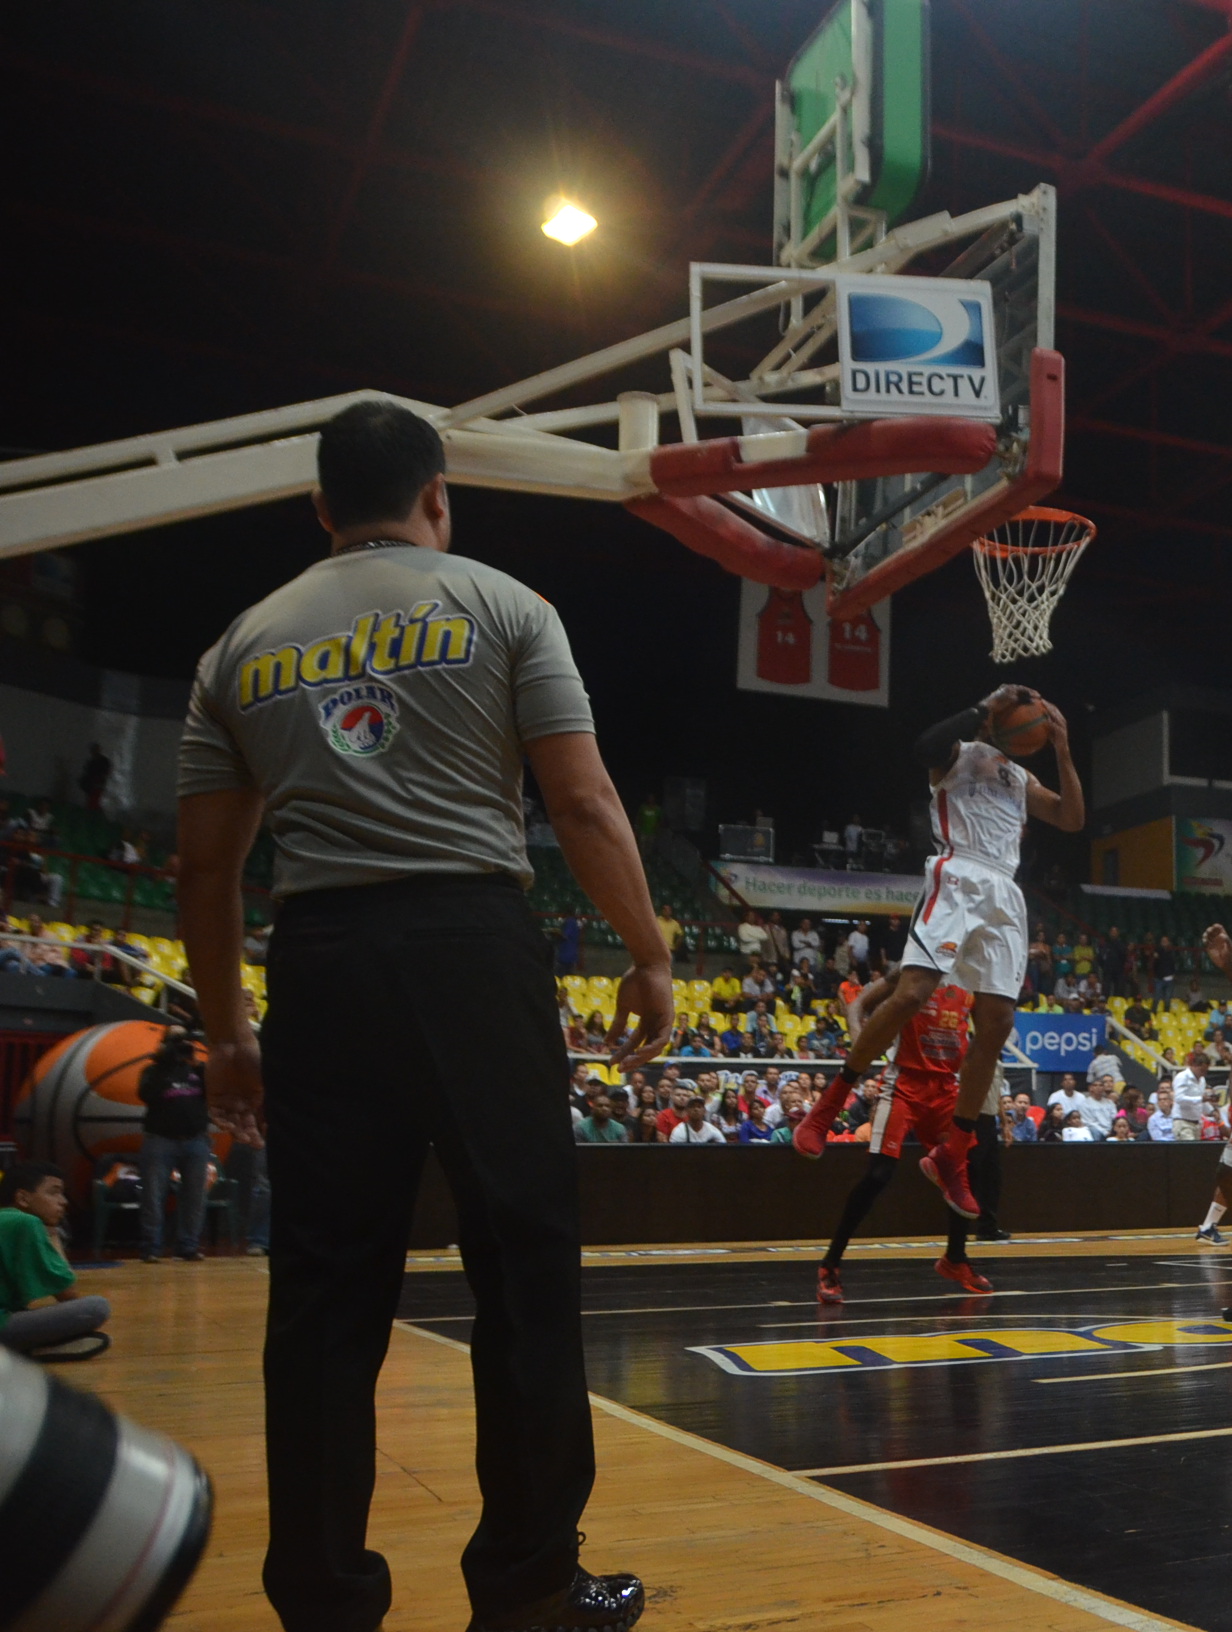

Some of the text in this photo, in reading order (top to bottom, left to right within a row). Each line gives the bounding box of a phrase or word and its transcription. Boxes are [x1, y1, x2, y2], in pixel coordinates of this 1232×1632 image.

[851, 368, 985, 399] DIRECTV
[775, 630, 797, 644] 14
[842, 621, 869, 642] 14
[239, 600, 477, 715] maltín
[319, 684, 398, 722] POLAR
[745, 876, 793, 895] Hacer
[798, 880, 861, 900] deporte
[866, 887, 882, 900] es
[1025, 1027, 1098, 1056] pepsi
